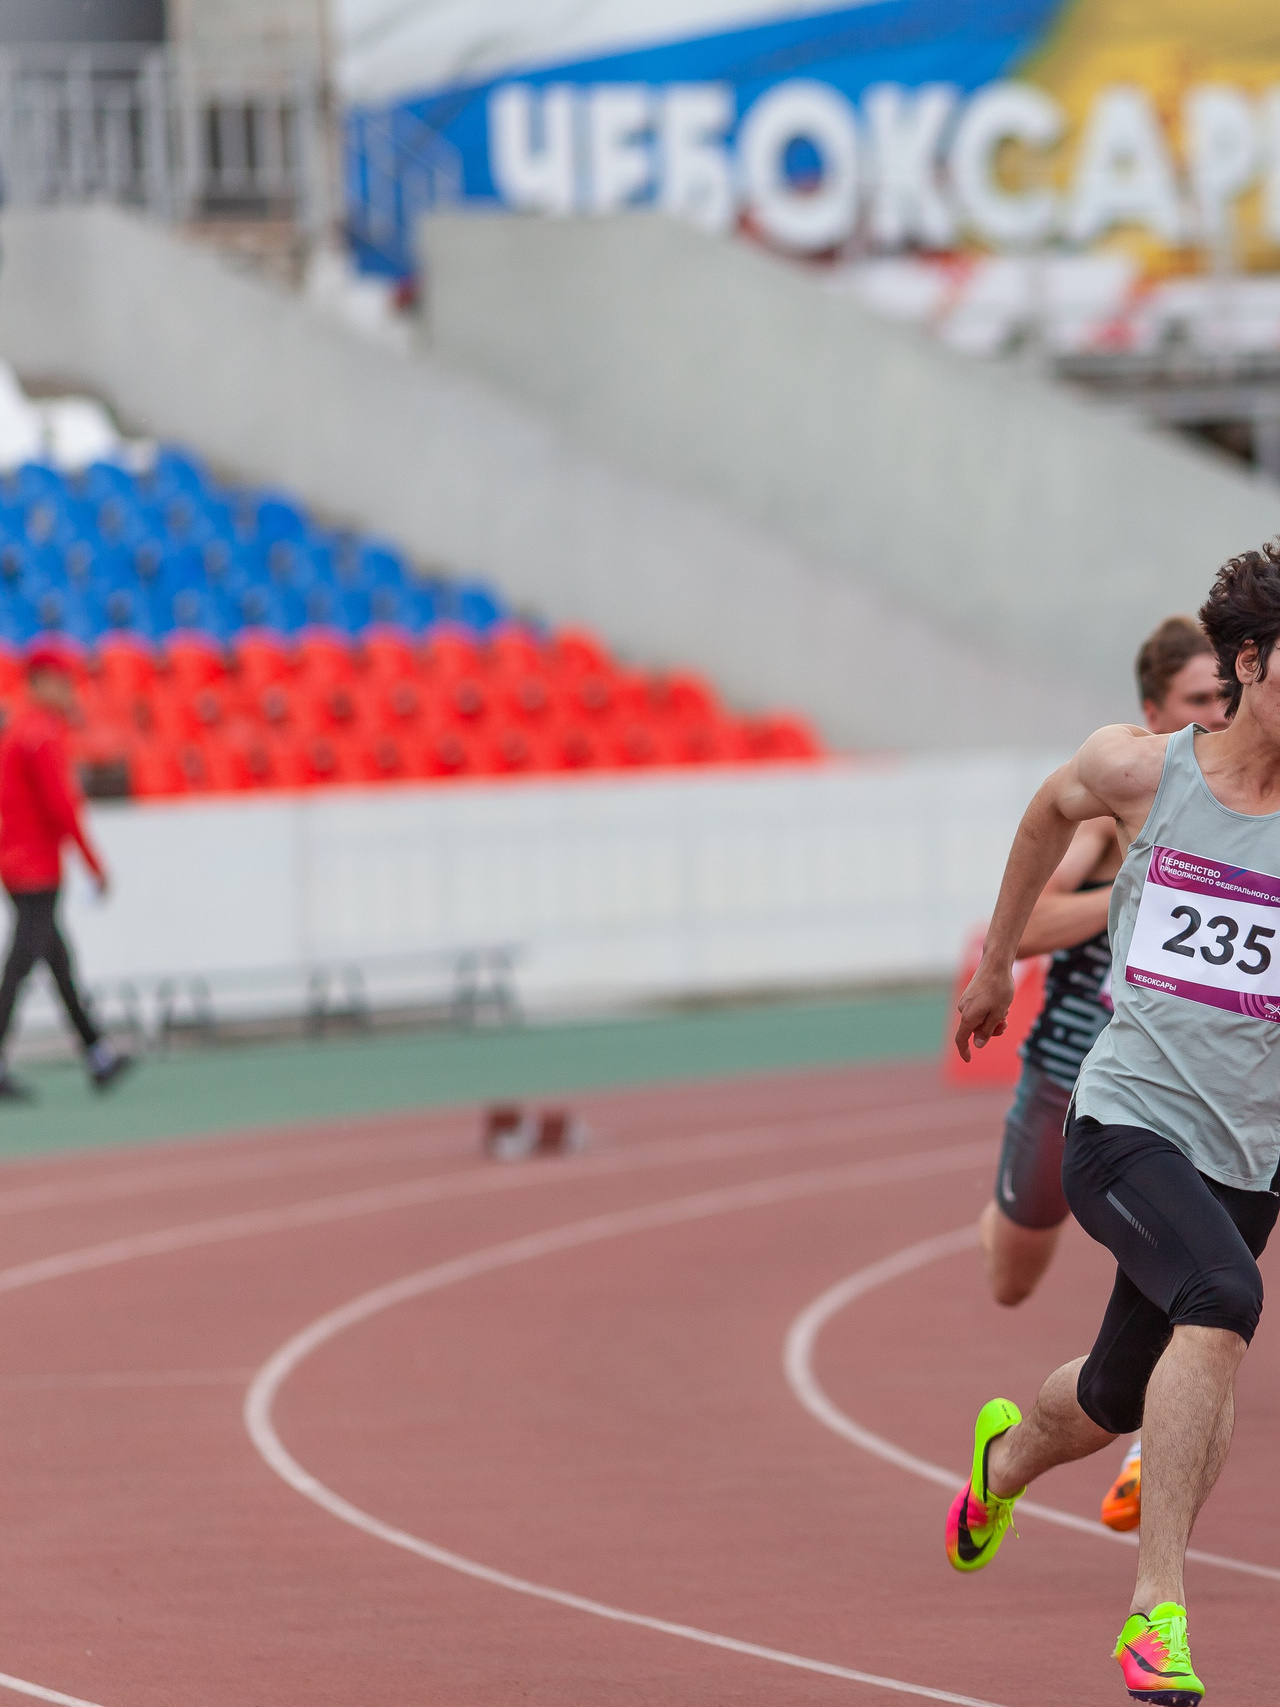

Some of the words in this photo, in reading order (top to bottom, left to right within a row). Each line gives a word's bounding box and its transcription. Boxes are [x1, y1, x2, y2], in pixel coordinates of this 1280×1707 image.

[1162, 856, 1221, 879] ПЕРВЕНСТВО
[1160, 865, 1215, 885] ПРИВОЛЖСКОГО
[1215, 881, 1270, 900] ФЕДЕРАЛЬНОГО
[1162, 905, 1276, 975] 235
[1133, 973, 1177, 991] ЧЕБОКСАРЫ
